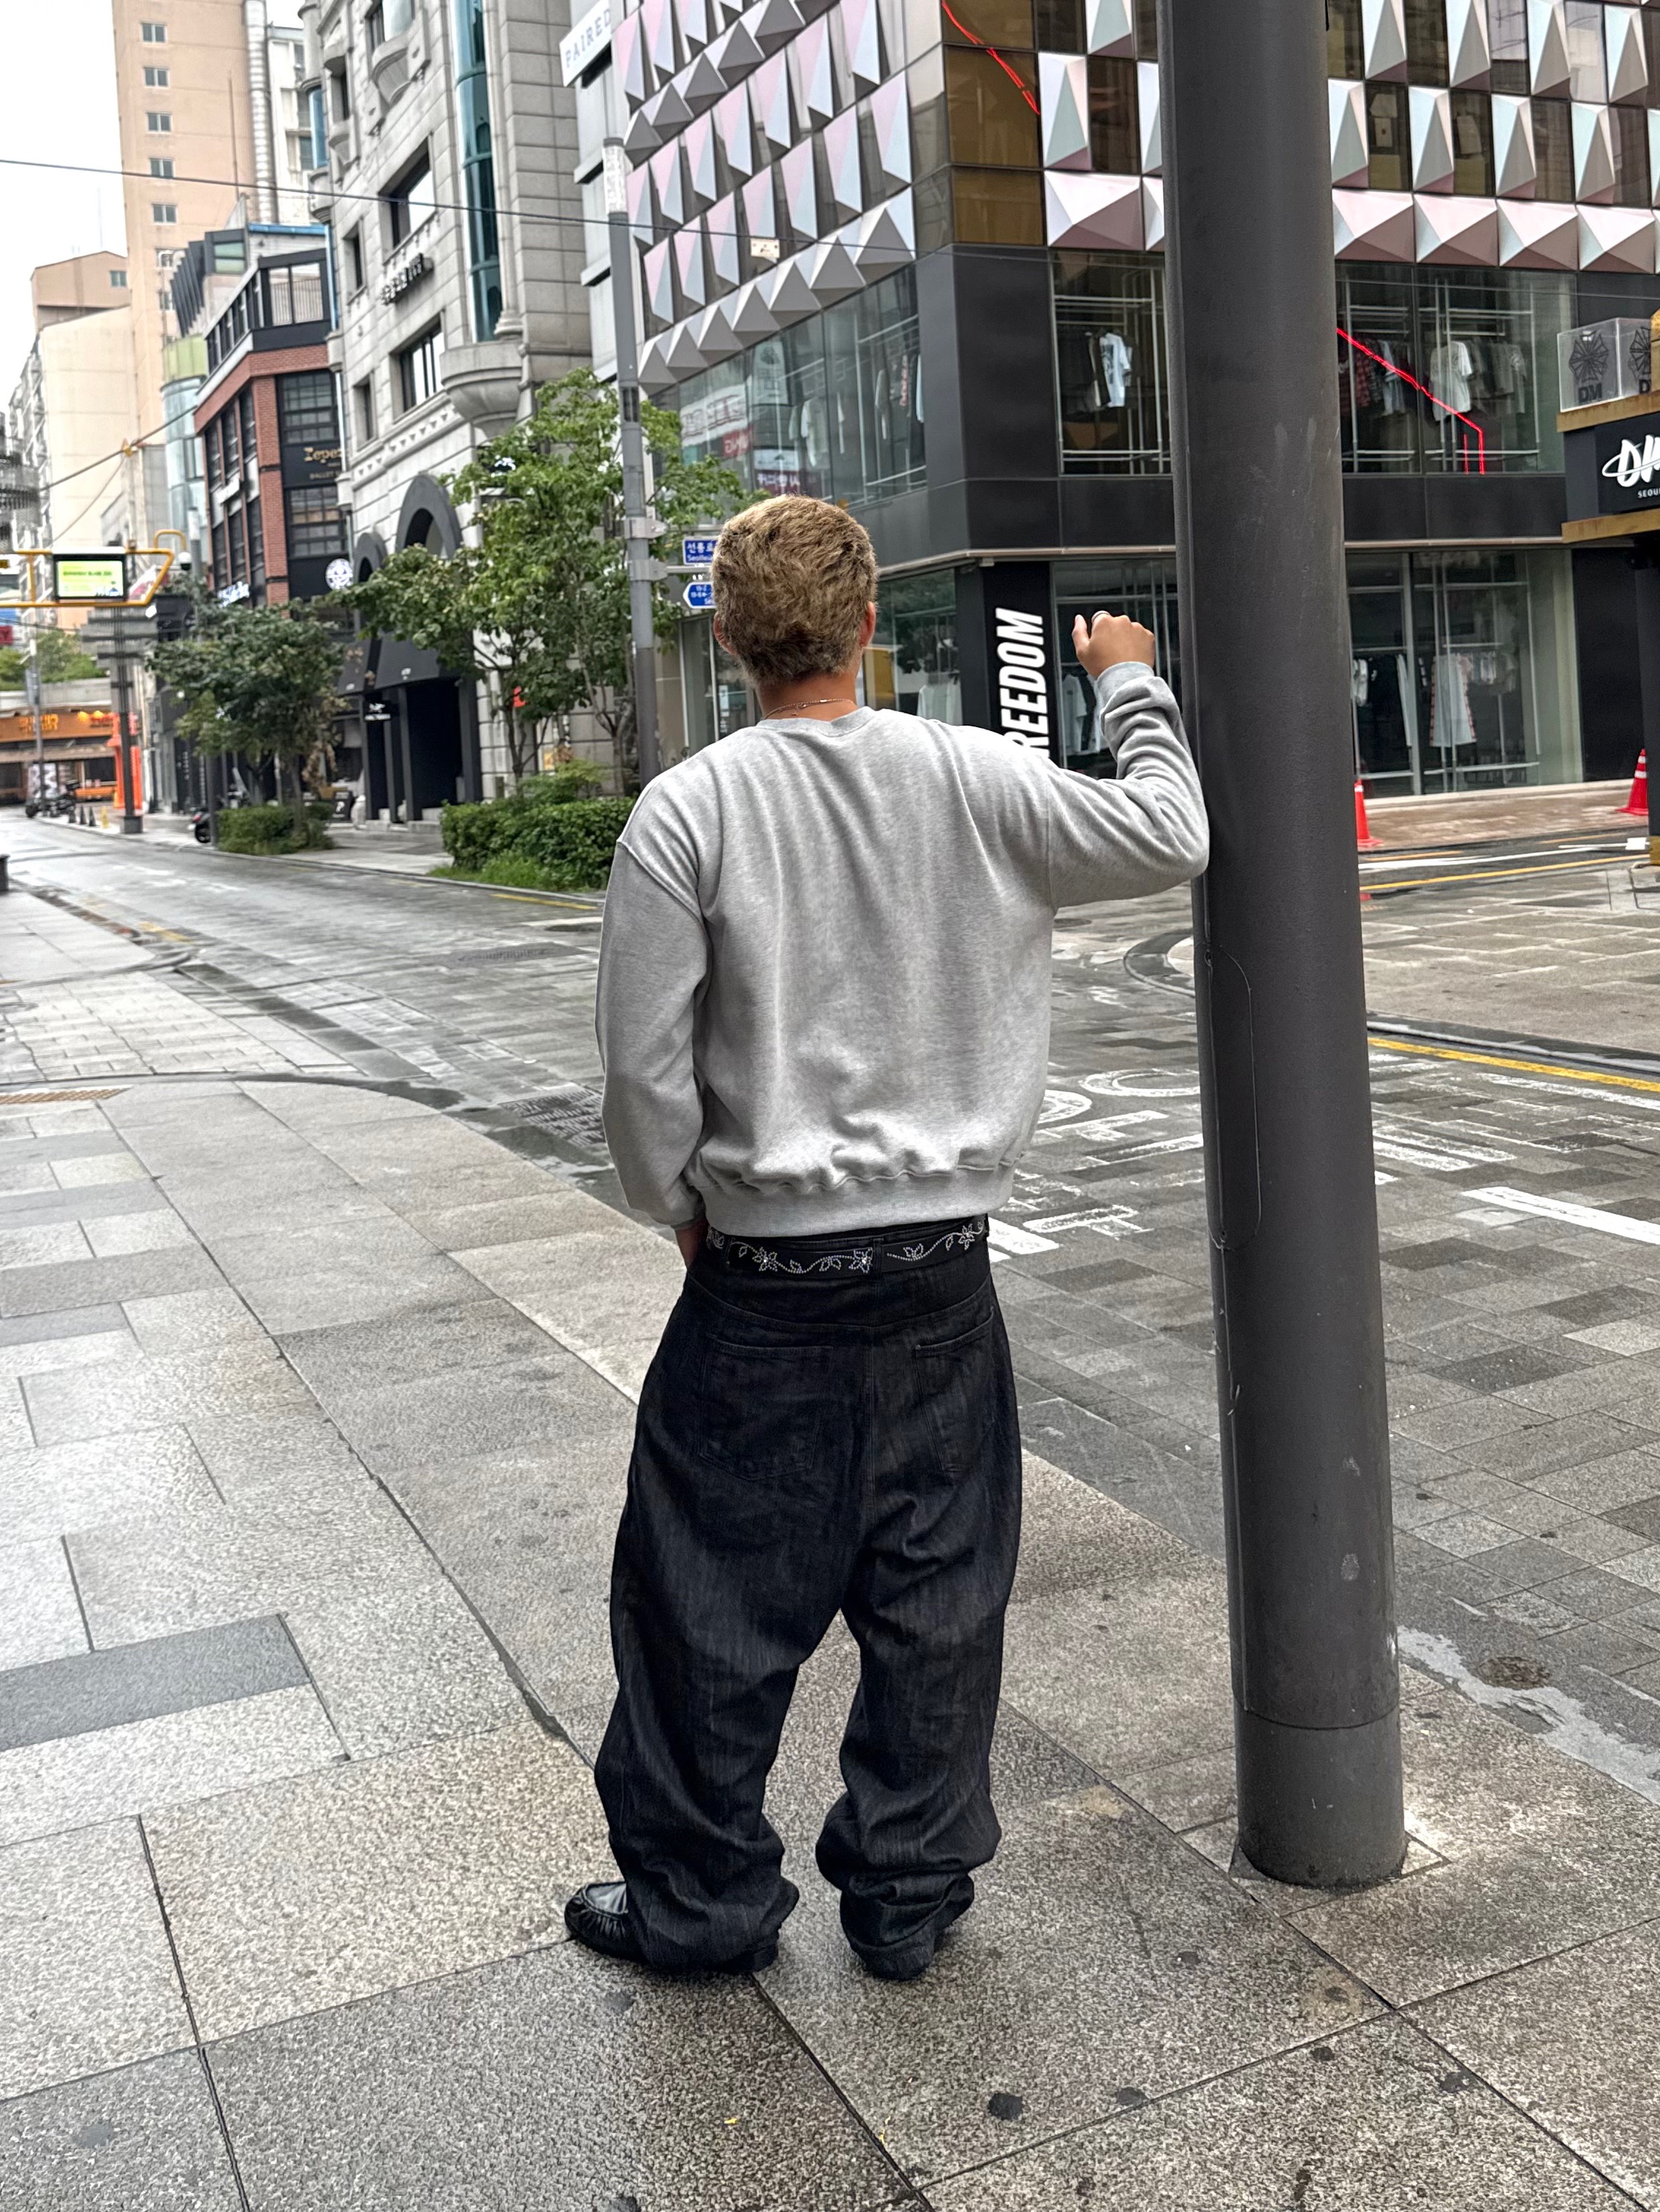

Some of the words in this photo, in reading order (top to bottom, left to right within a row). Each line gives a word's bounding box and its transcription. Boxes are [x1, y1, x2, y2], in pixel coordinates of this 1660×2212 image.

[565, 8, 611, 68] PAIRED
[1638, 379, 1651, 395] D
[995, 607, 1050, 759] REEDOM
